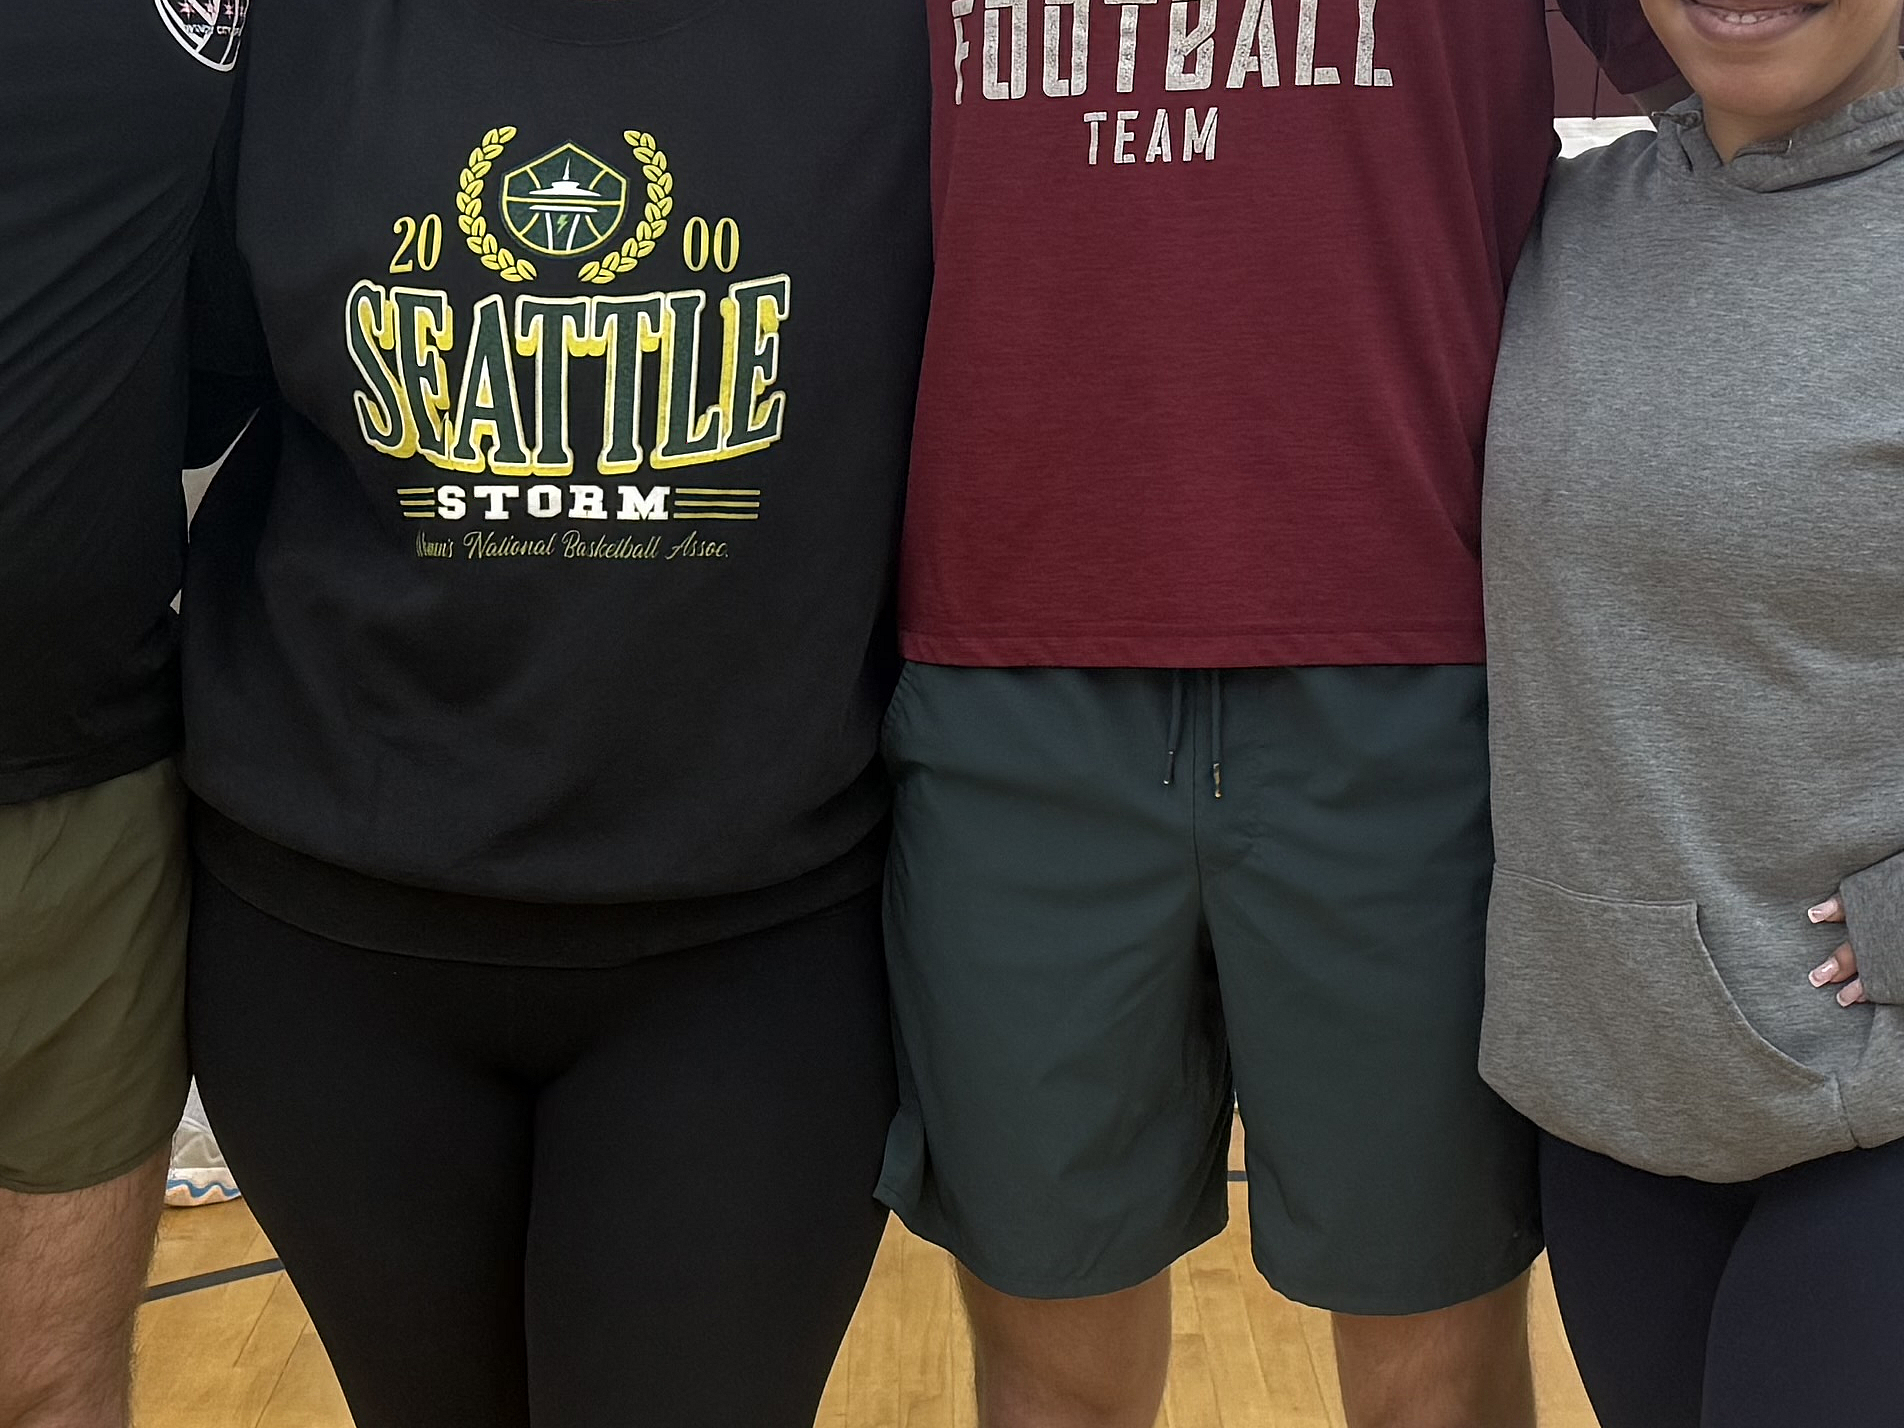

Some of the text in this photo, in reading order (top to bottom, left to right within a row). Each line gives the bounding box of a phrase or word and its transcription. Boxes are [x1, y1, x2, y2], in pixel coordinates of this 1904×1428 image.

[1083, 106, 1220, 166] TEAM
[389, 213, 741, 275] 20 00
[344, 272, 792, 477] SEATTLE
[436, 484, 674, 521] STORM
[462, 530, 558, 559] National
[560, 529, 663, 559] Basketball
[664, 530, 730, 560] Assoc.
